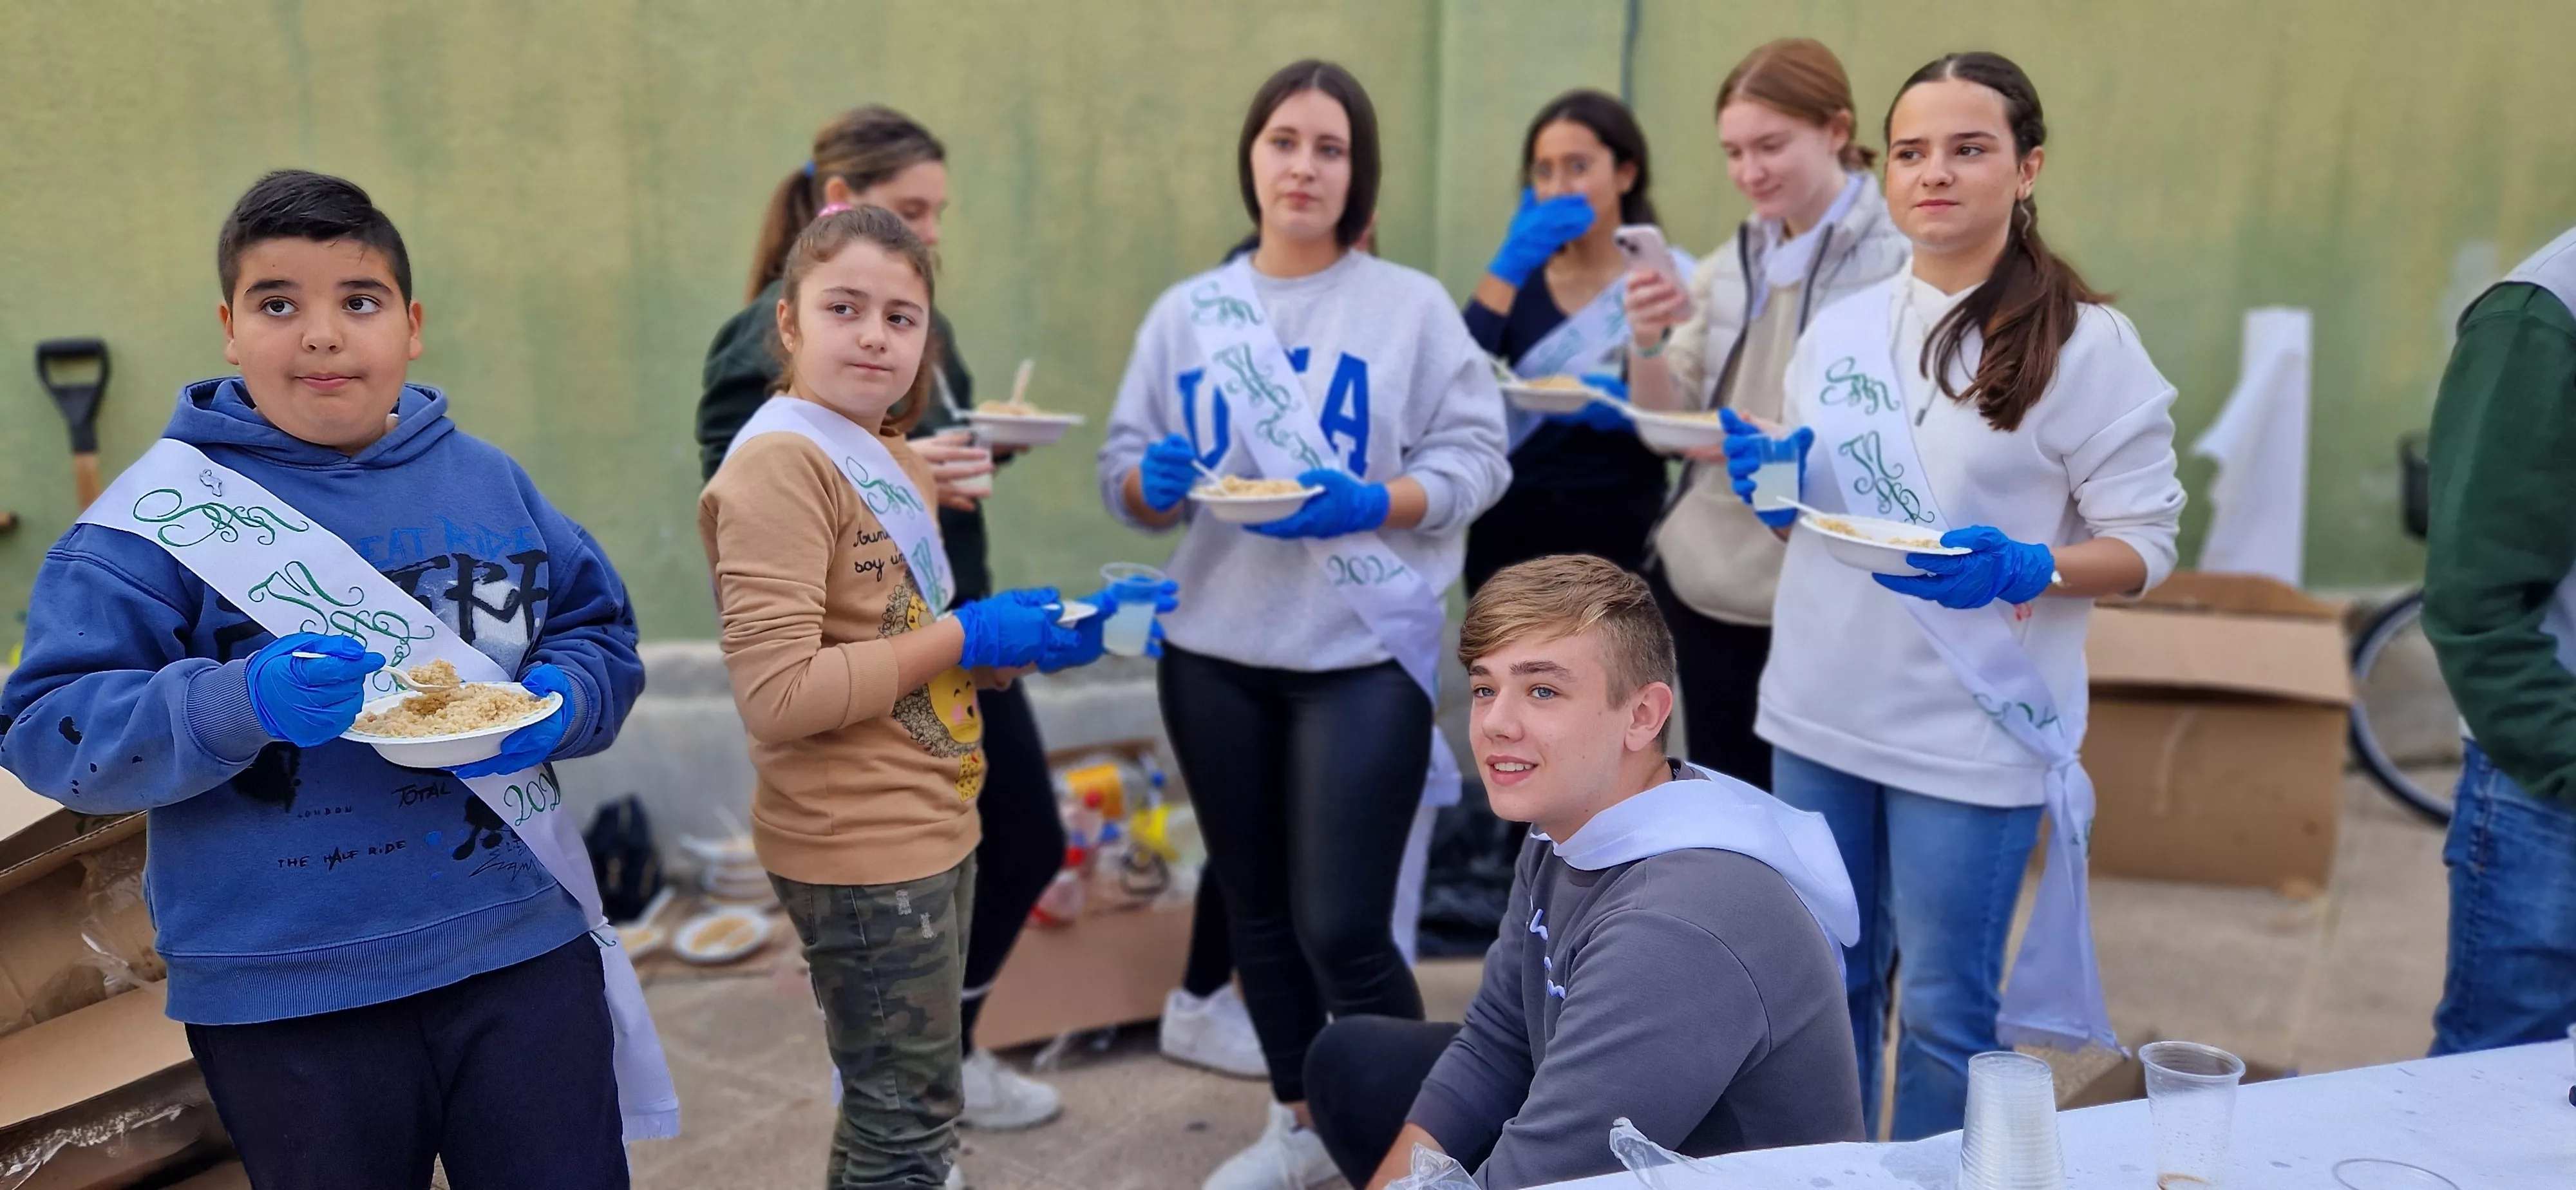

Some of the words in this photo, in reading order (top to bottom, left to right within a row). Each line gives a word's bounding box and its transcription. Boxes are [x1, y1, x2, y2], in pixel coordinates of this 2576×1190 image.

[854, 557, 884, 582] soy
[391, 782, 451, 808] TOTAL
[277, 855, 310, 868] THE
[323, 846, 359, 871] HALF
